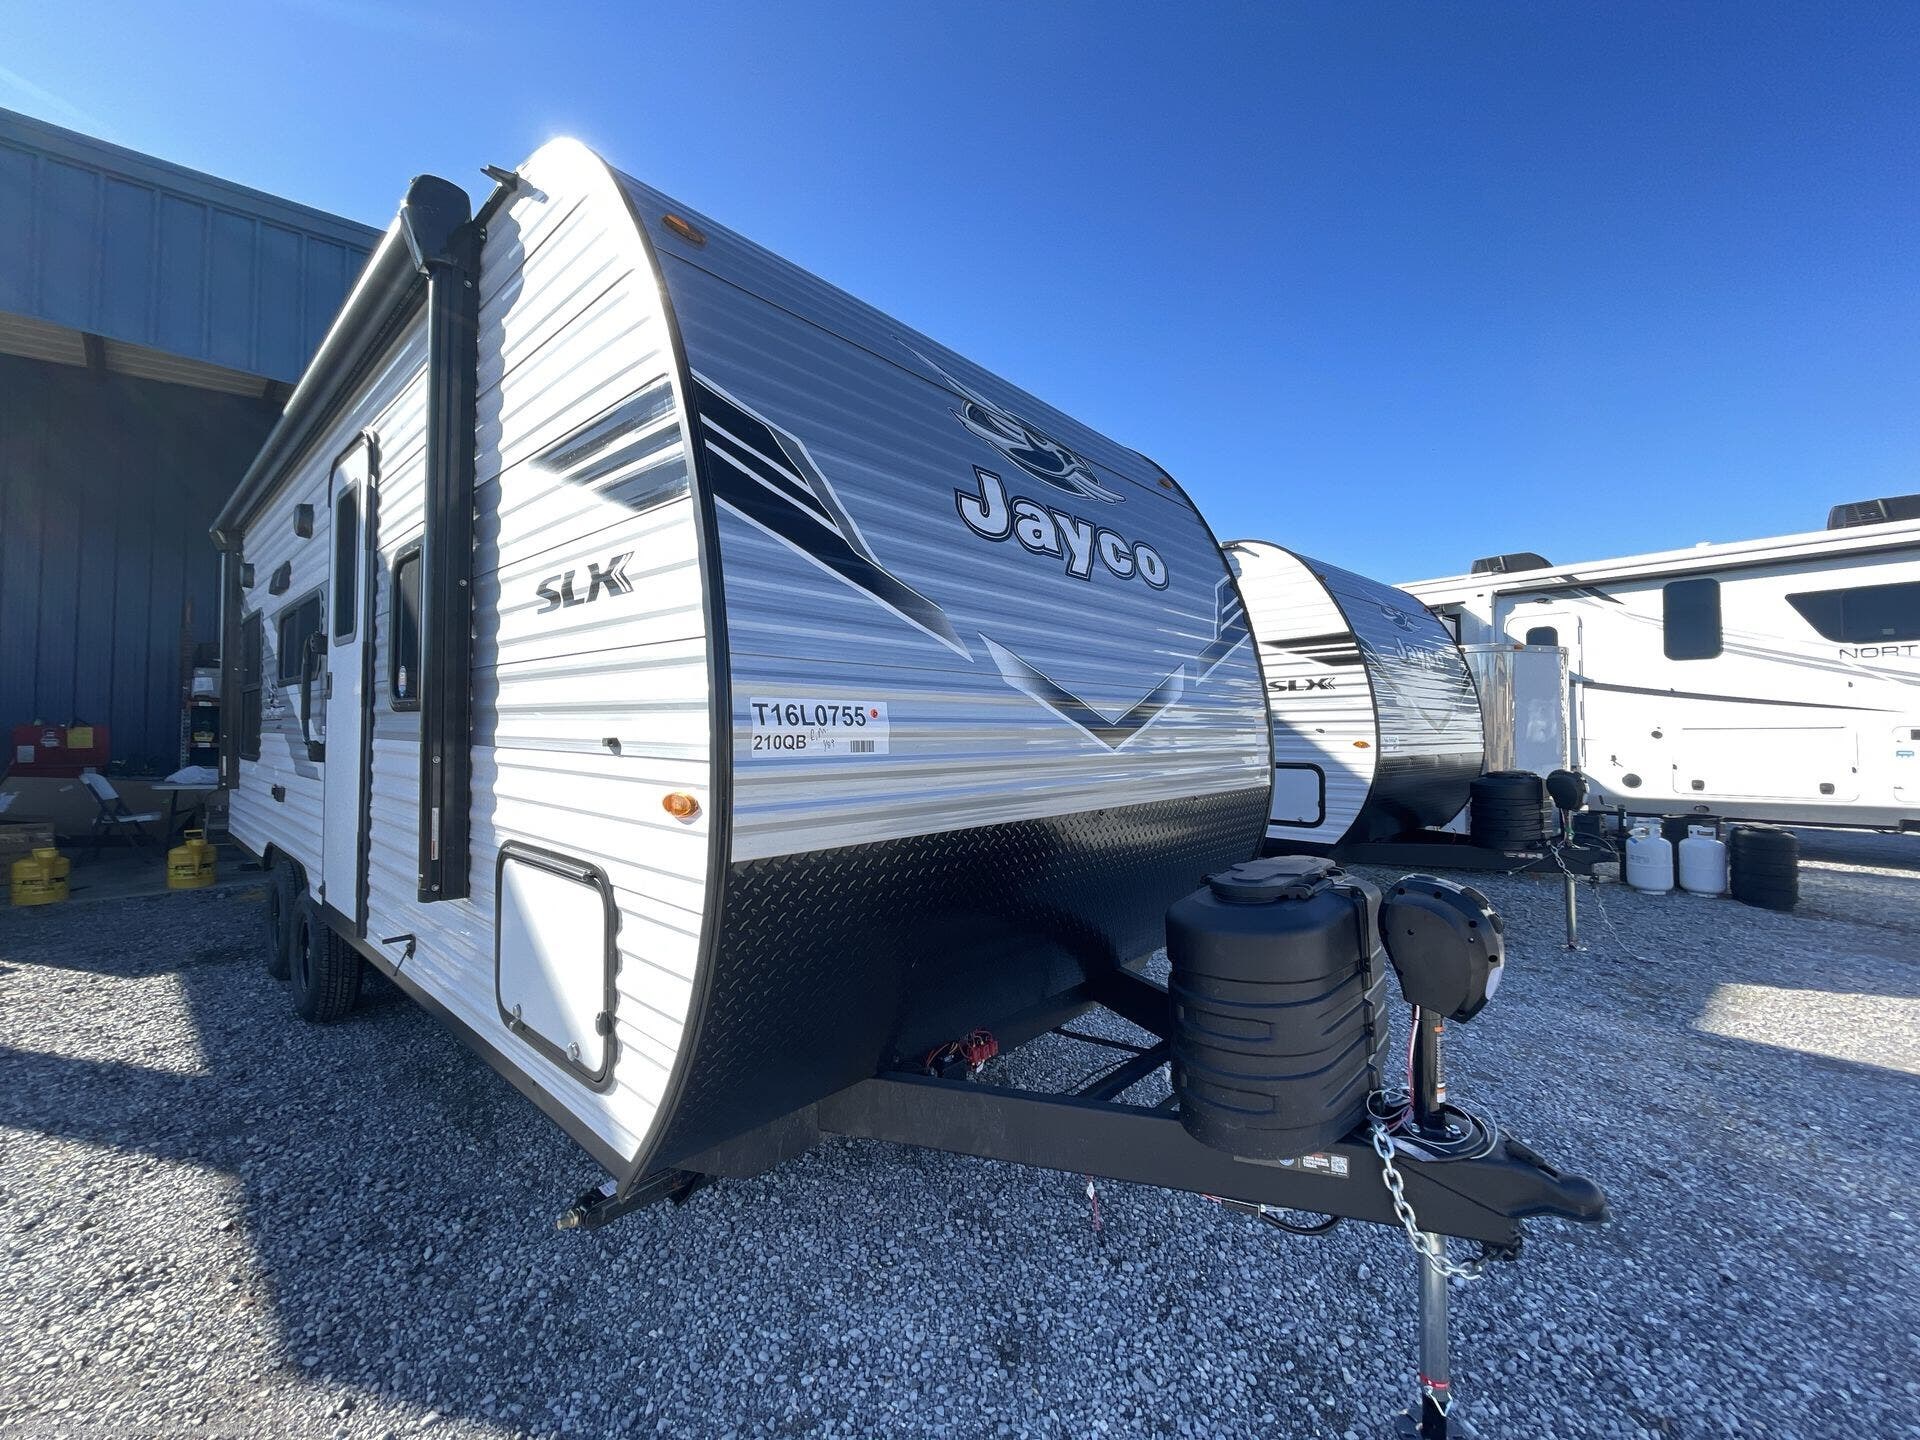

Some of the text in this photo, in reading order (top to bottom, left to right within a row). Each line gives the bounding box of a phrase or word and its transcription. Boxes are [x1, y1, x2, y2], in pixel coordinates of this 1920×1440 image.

[954, 464, 1170, 591] Jayco
[536, 551, 635, 615] SLX
[1839, 645, 1919, 659] NORT
[1267, 677, 1336, 693] SLX
[751, 702, 868, 727] T16L0755
[753, 734, 807, 751] 210QB
